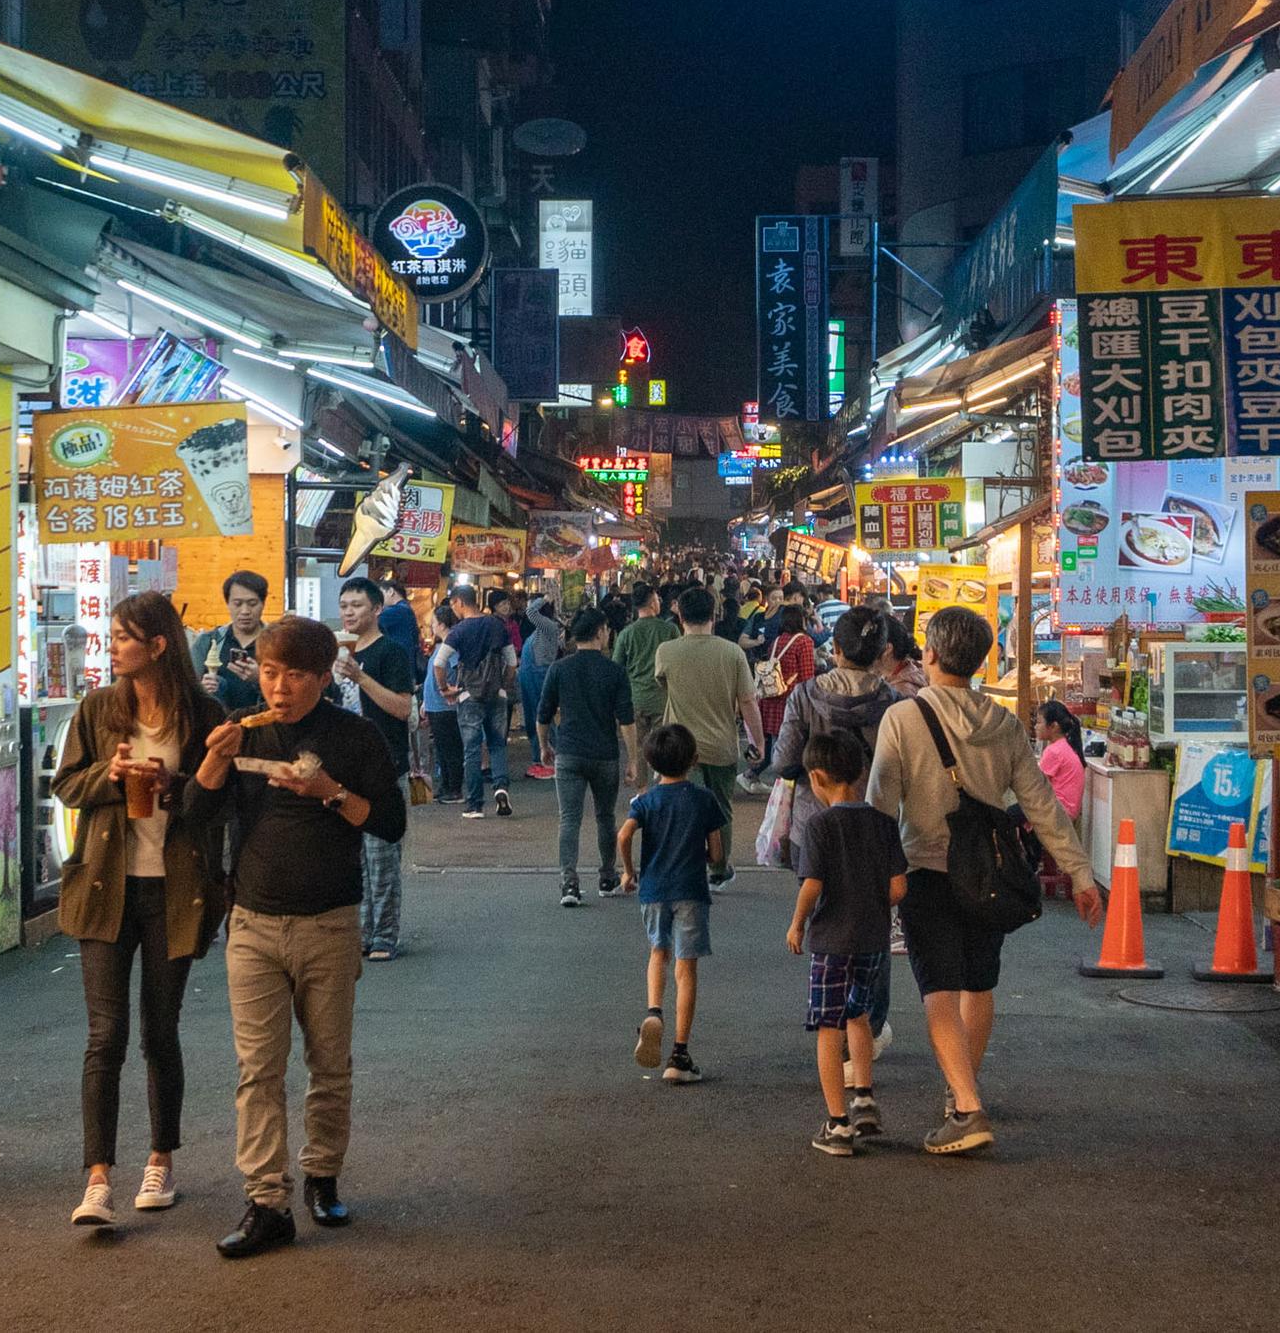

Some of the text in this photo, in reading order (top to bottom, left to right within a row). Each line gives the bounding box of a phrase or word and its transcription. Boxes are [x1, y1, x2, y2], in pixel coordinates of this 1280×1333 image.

[392, 258, 467, 274] 紅茶霜淇淋
[766, 258, 799, 418] 袁家美食
[1087, 298, 1143, 458] 總匯大刈包
[1158, 295, 1215, 455] 豆干扣肉夾
[43, 470, 185, 501] 阿薩姆紅茶
[890, 486, 932, 501] 福記
[401, 509, 444, 534] 香腸
